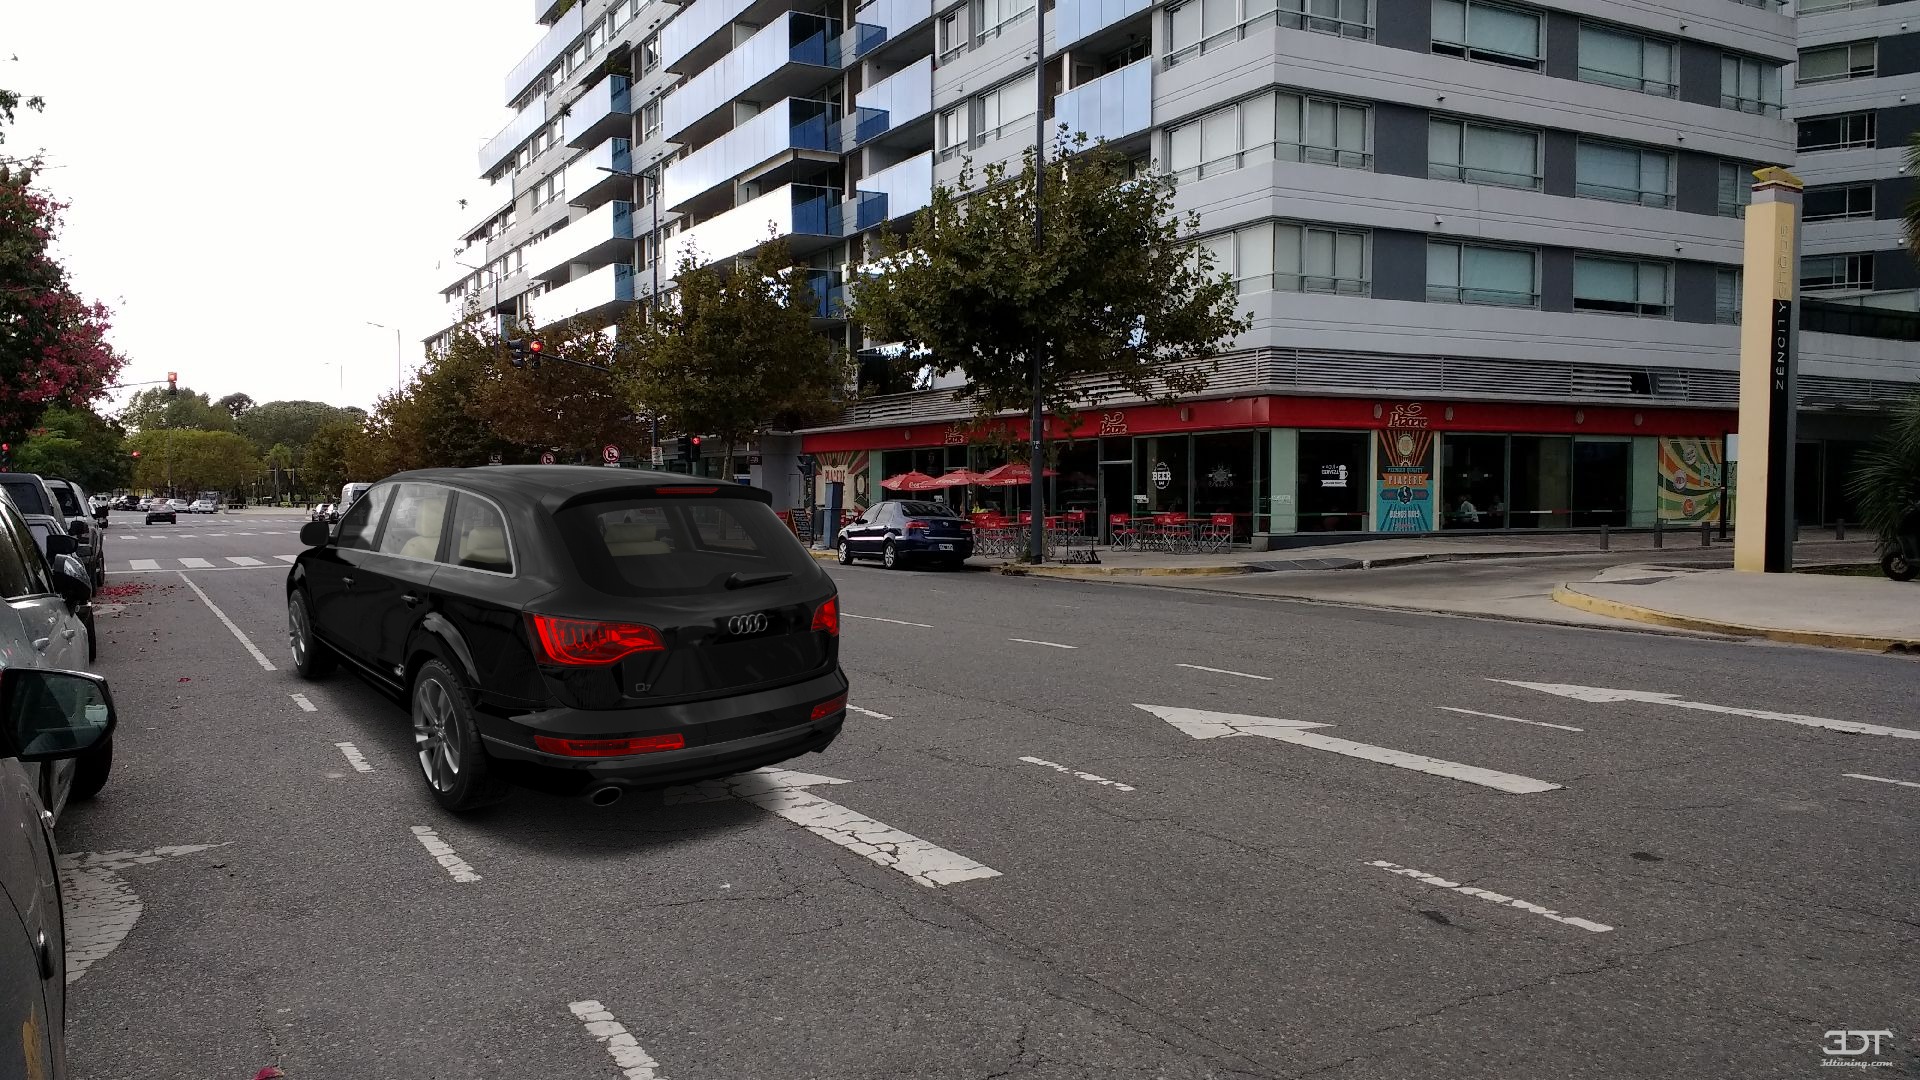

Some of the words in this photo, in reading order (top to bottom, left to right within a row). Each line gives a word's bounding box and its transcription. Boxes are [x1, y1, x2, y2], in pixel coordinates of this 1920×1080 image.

[1775, 301, 1787, 391] ZENCITY
[1152, 471, 1171, 480] BEER
[1388, 475, 1423, 485] PIACERE
[635, 682, 652, 692] Q7
